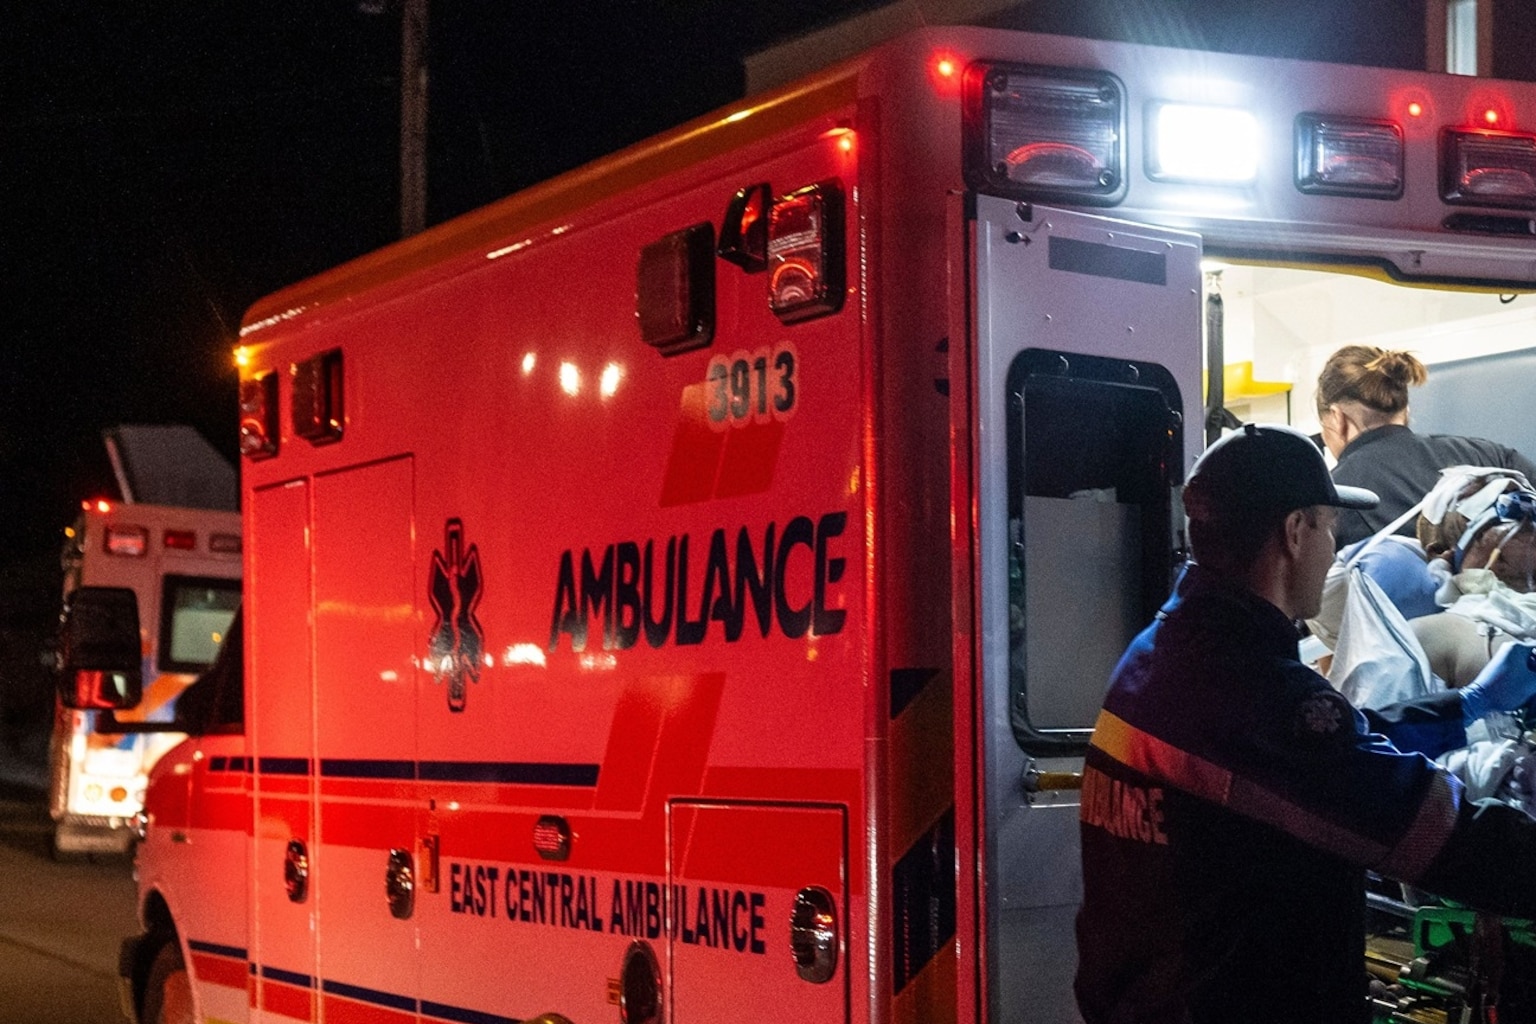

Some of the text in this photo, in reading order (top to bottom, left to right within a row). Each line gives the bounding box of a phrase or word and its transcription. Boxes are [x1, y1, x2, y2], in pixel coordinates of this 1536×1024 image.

[708, 350, 795, 423] 3913
[549, 511, 847, 653] AMBULANCE
[450, 863, 766, 955] EAST CENTRAL AMBULANCE
